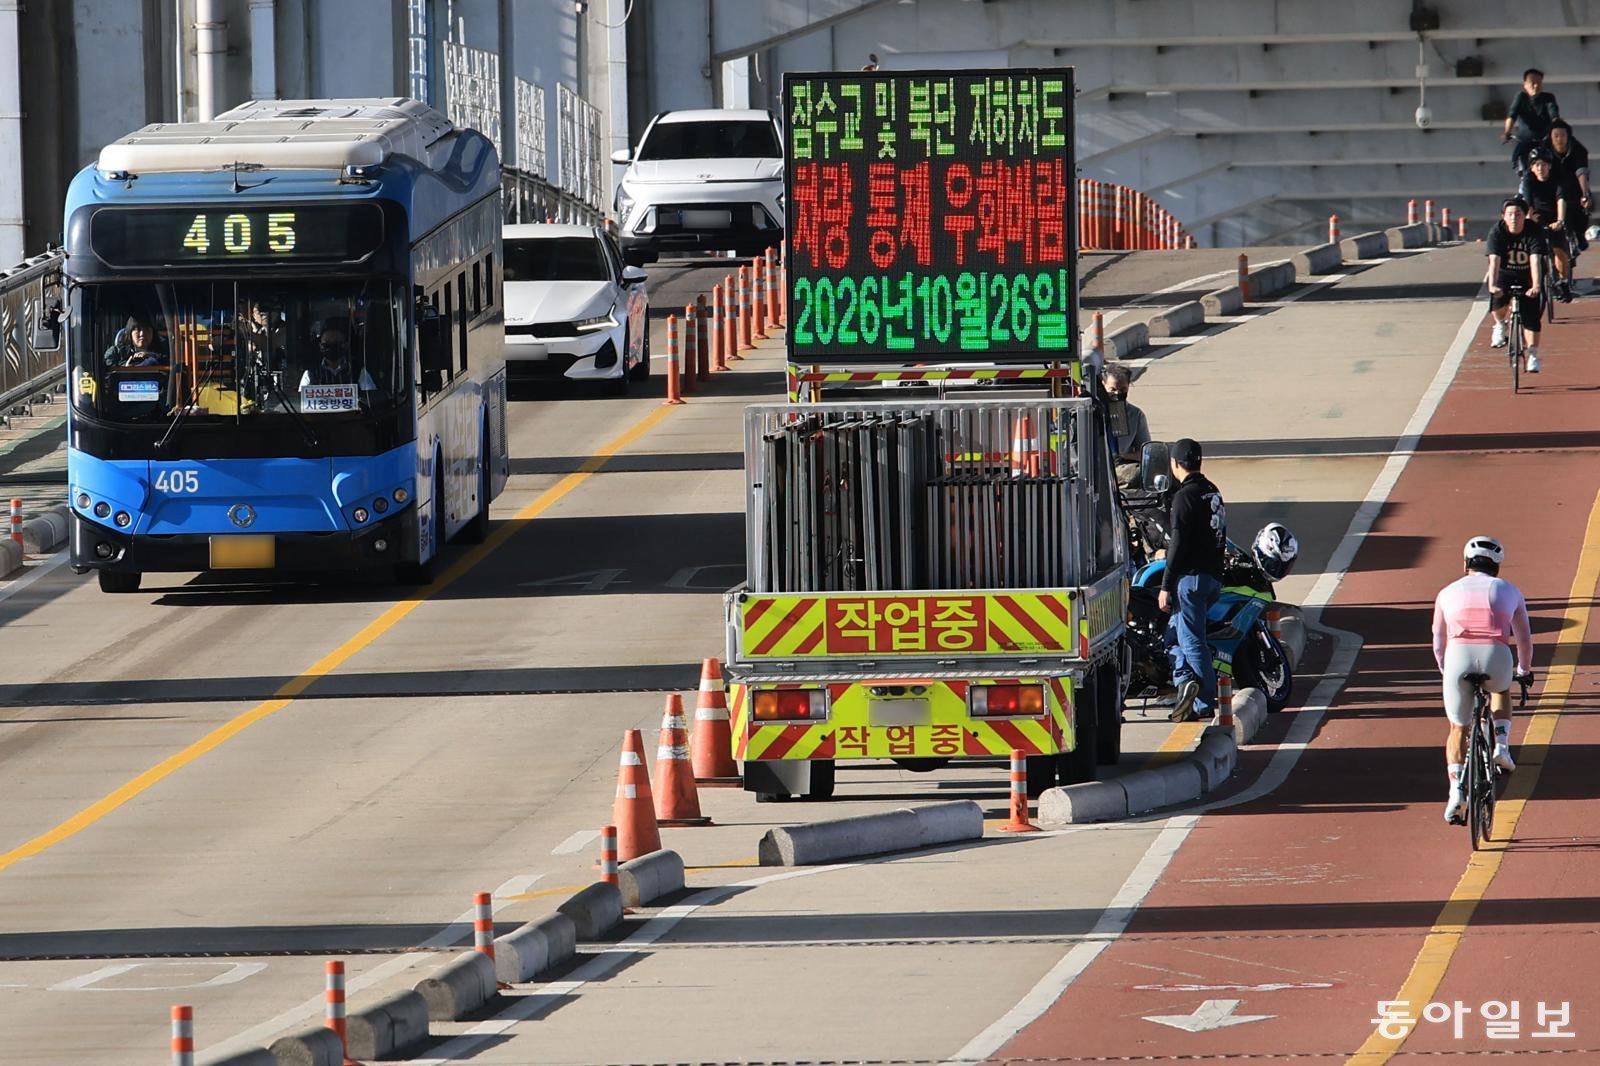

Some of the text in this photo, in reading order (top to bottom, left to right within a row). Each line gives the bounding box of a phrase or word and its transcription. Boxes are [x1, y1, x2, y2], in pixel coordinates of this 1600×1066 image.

[792, 76, 1066, 159] 잠수교 및 북단 지하차도
[183, 213, 296, 254] 405
[793, 158, 1066, 269] 차량 통제 우회바람
[155, 470, 199, 493] 405
[834, 599, 978, 651] 작업중
